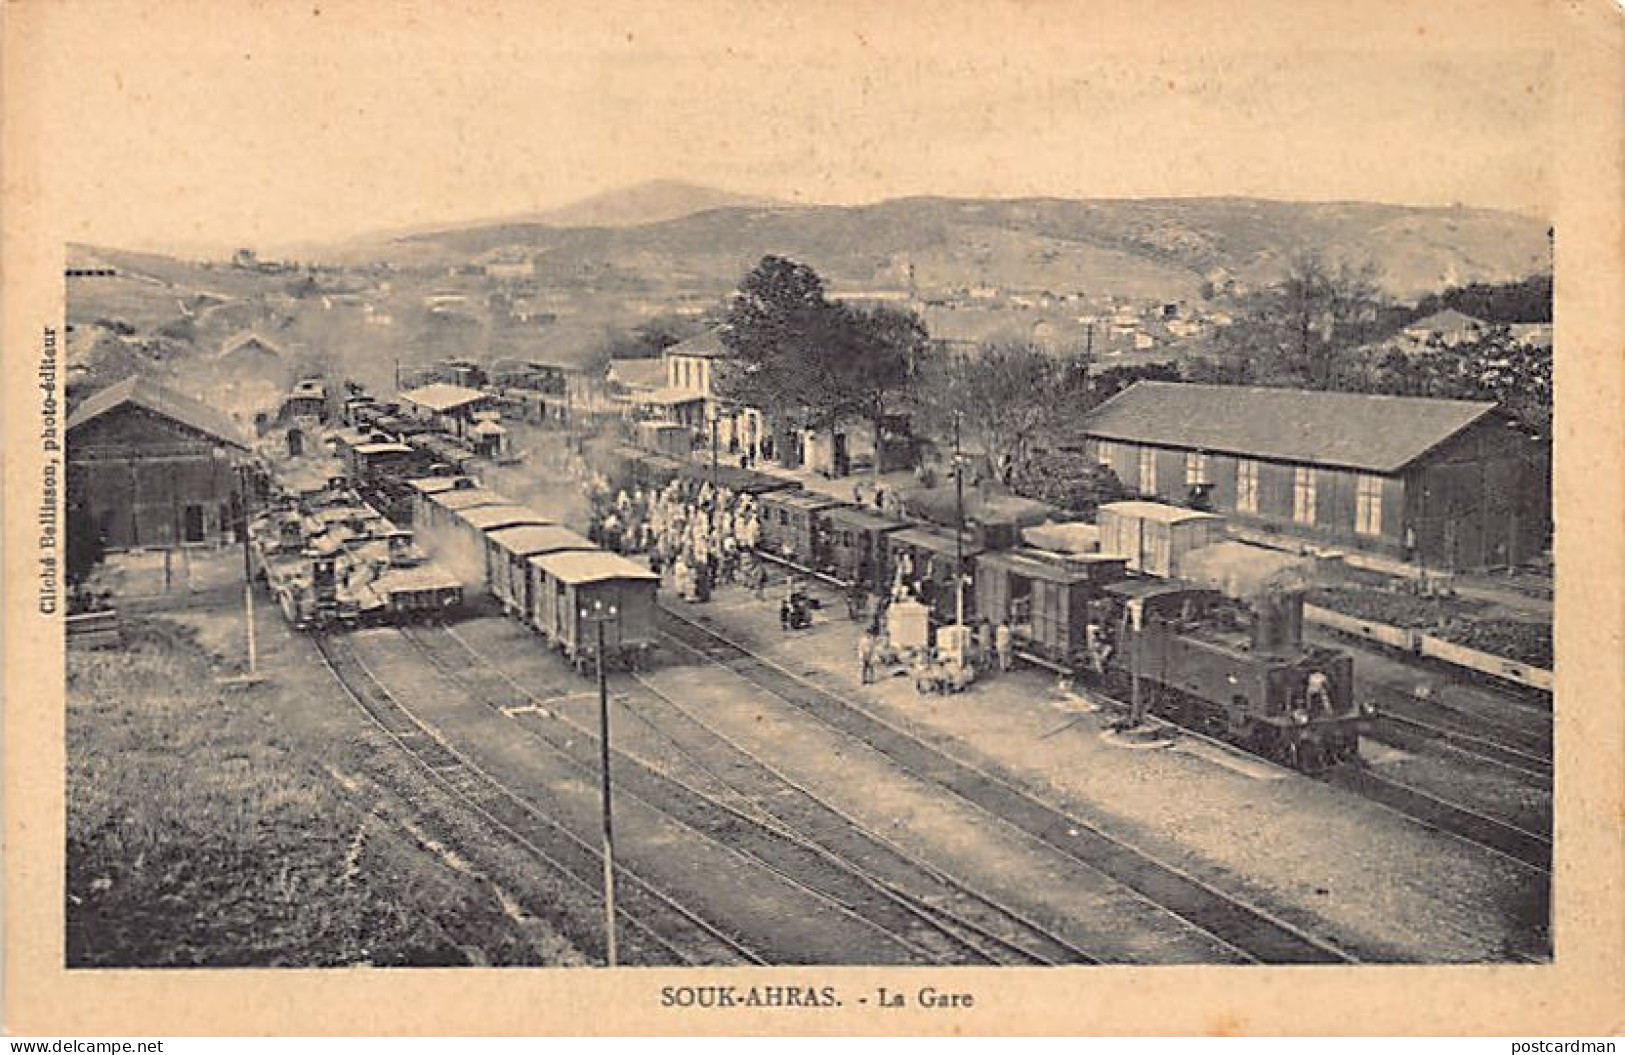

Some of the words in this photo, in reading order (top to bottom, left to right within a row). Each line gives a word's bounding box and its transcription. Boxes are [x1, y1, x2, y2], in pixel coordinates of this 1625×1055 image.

[38, 327, 60, 452] photo-éditeur
[38, 557, 56, 614] Cliché
[661, 986, 843, 1007] SOUK-AHRAS.
[878, 987, 905, 1007] La
[919, 987, 974, 1008] Gare
